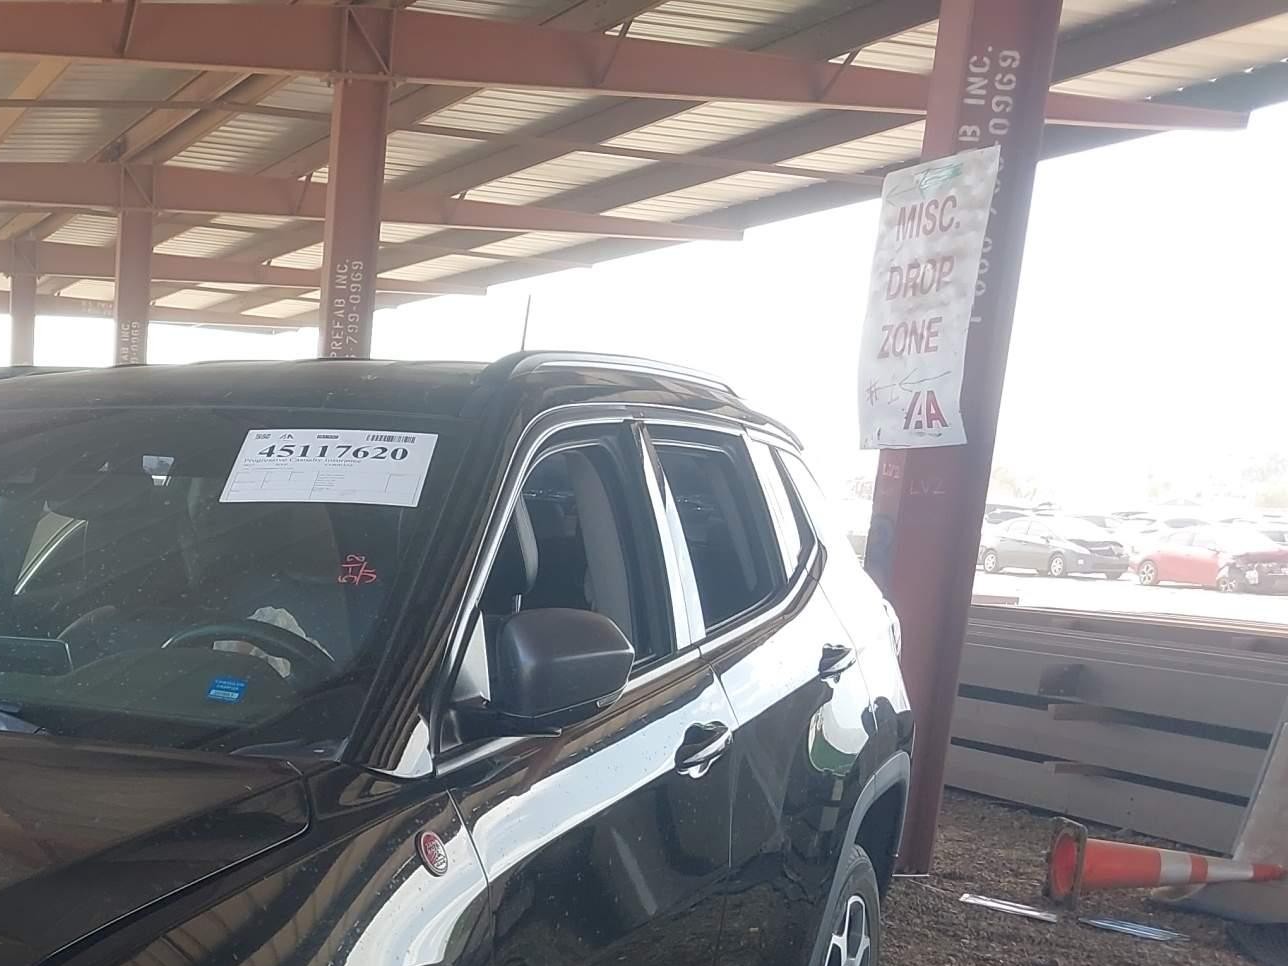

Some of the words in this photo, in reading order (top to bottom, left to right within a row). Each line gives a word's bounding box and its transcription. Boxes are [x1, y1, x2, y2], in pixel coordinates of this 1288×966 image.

[963, 46, 993, 105] INC.
[896, 194, 962, 242] MISC.
[335, 259, 349, 289] INC.
[886, 255, 956, 301] DROP
[877, 316, 943, 359] ZONE
[258, 444, 409, 461] 45117620
